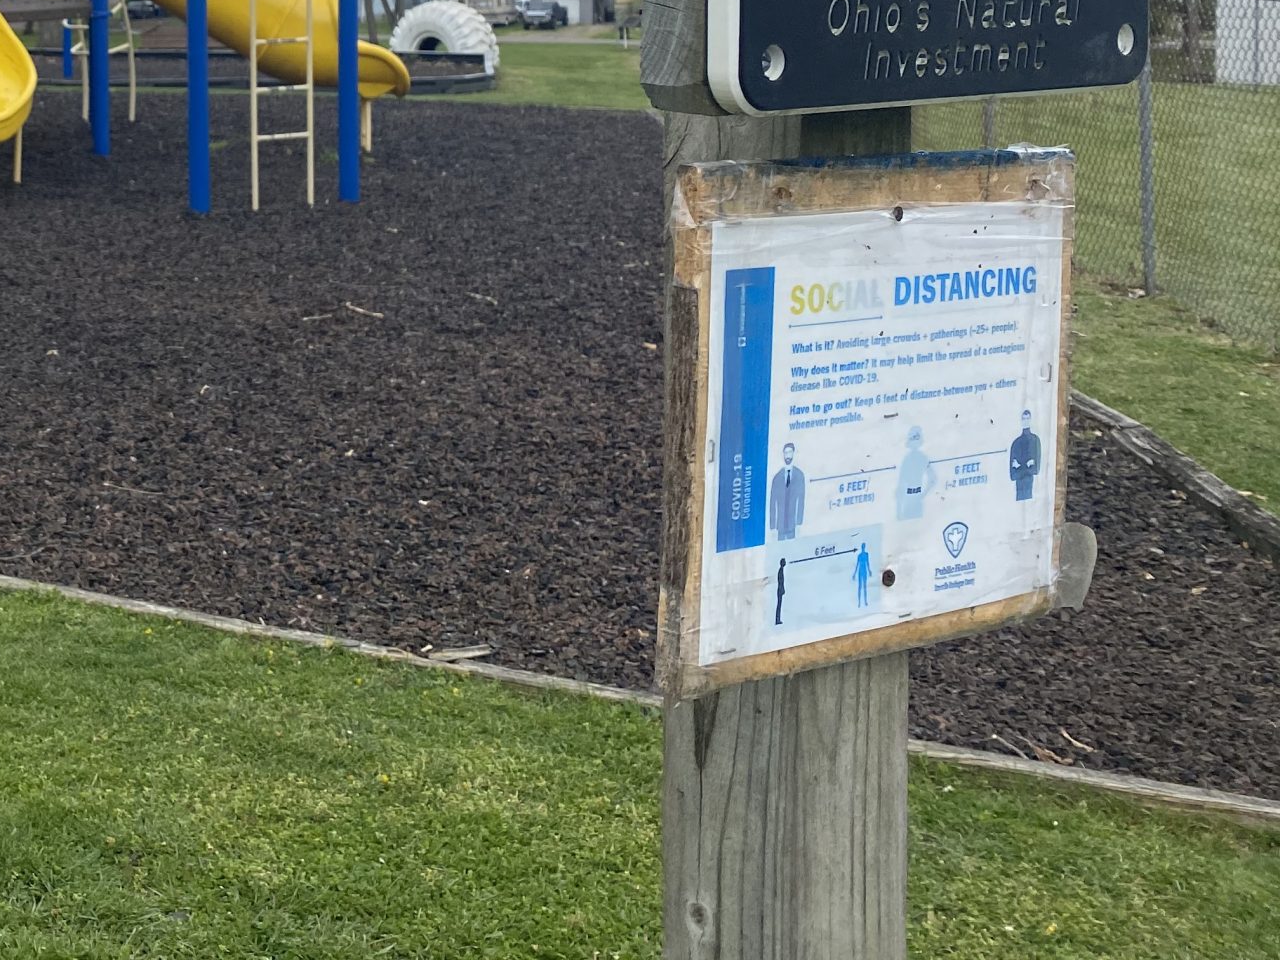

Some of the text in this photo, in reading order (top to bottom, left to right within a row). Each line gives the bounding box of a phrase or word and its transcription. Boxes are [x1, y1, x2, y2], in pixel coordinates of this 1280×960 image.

[862, 35, 1047, 81] Investment
[788, 279, 886, 316] SOCIAL
[893, 265, 1038, 307] DISTANCING
[791, 343, 813, 354] What
[815, 341, 823, 351] is
[824, 340, 835, 351] it?
[836, 337, 870, 350] Avoiding
[871, 335, 891, 347] large
[893, 332, 921, 344] crowds
[930, 327, 968, 342] gatherings
[790, 366, 809, 379] Why
[810, 364, 830, 376] does
[831, 362, 838, 373] it
[839, 358, 869, 372] matter?
[879, 357, 896, 368] may
[897, 354, 914, 367] help
[916, 351, 934, 364] limit
[935, 349, 947, 361] the
[948, 348, 973, 361] spread
[973, 346, 982, 357] of
[988, 342, 1026, 355] contagious
[790, 372, 880, 393] disease like COVID-19.
[789, 404, 810, 416] Have
[812, 403, 821, 413] to
[823, 403, 833, 414] go
[835, 398, 853, 410] out?
[854, 396, 874, 408] Keep
[883, 393, 899, 404] feet
[900, 390, 908, 401] of
[910, 388, 942, 401] distance
[942, 384, 973, 396] between
[974, 382, 988, 395] you
[995, 378, 1017, 389] others
[789, 417, 828, 431] whenever
[953, 462, 982, 475] 6 FEET
[958, 474, 988, 487] METERS)
[731, 453, 743, 521] COVID-19
[740, 465, 752, 520] Coronavirus
[838, 480, 868, 494] 6 FEET
[843, 492, 875, 507] METERS)
[814, 544, 836, 556] 6 Feet
